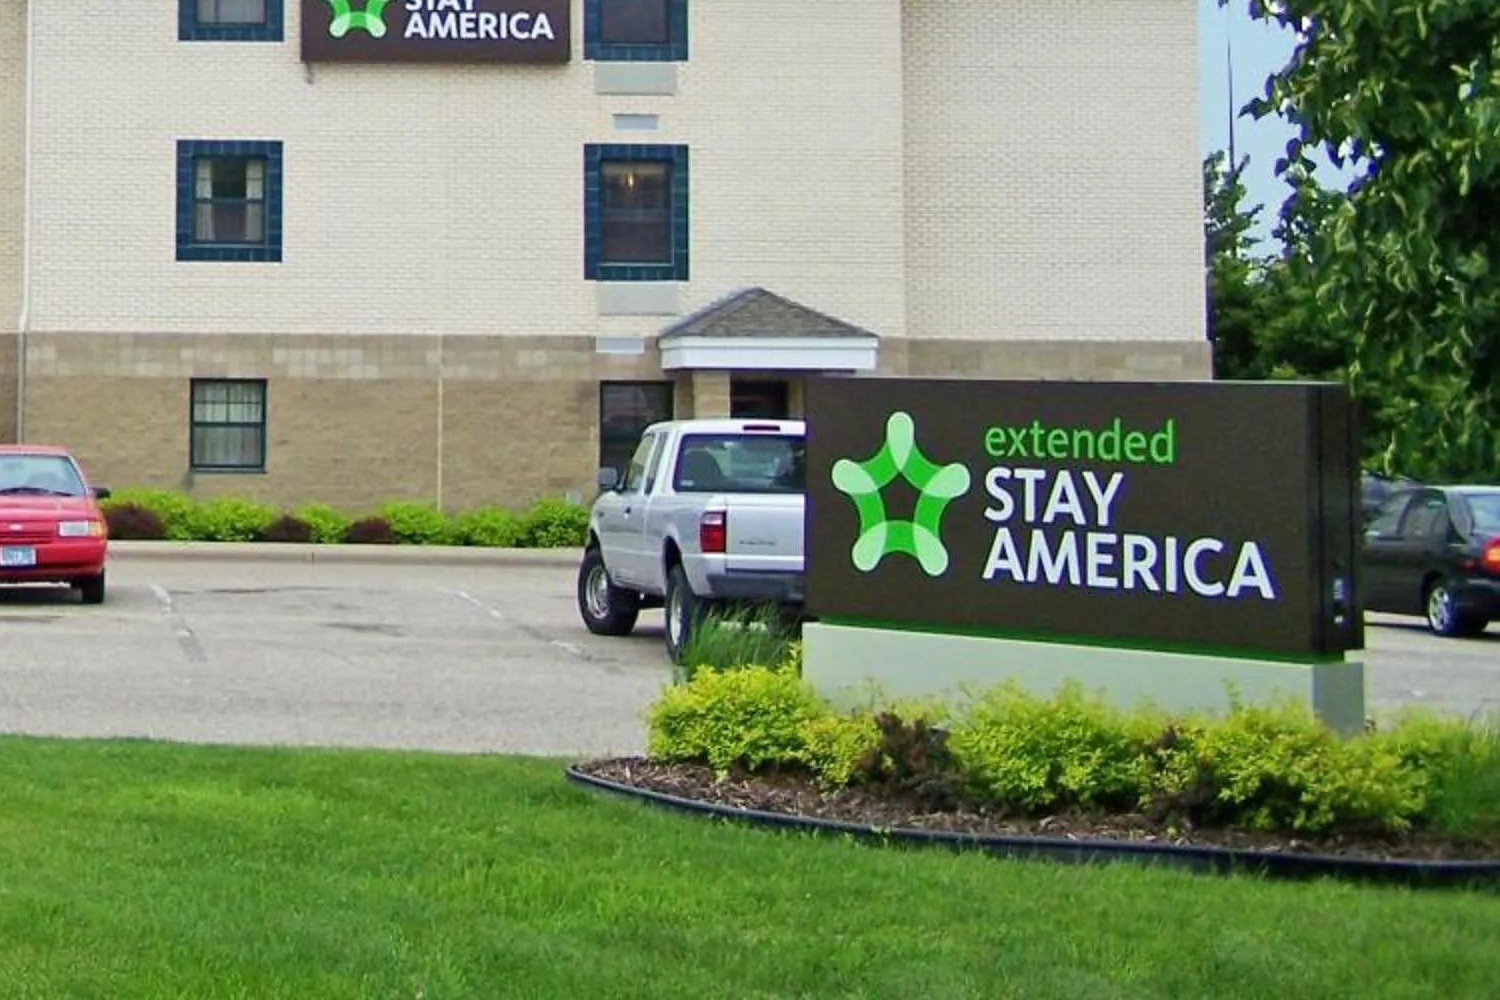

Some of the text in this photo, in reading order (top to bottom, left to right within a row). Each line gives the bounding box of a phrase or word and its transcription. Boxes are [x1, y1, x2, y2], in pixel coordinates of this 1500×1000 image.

[404, 13, 555, 40] AMERICA
[984, 418, 1176, 464] extended
[983, 467, 1124, 527] STAY
[982, 528, 1277, 600] AMERICA
